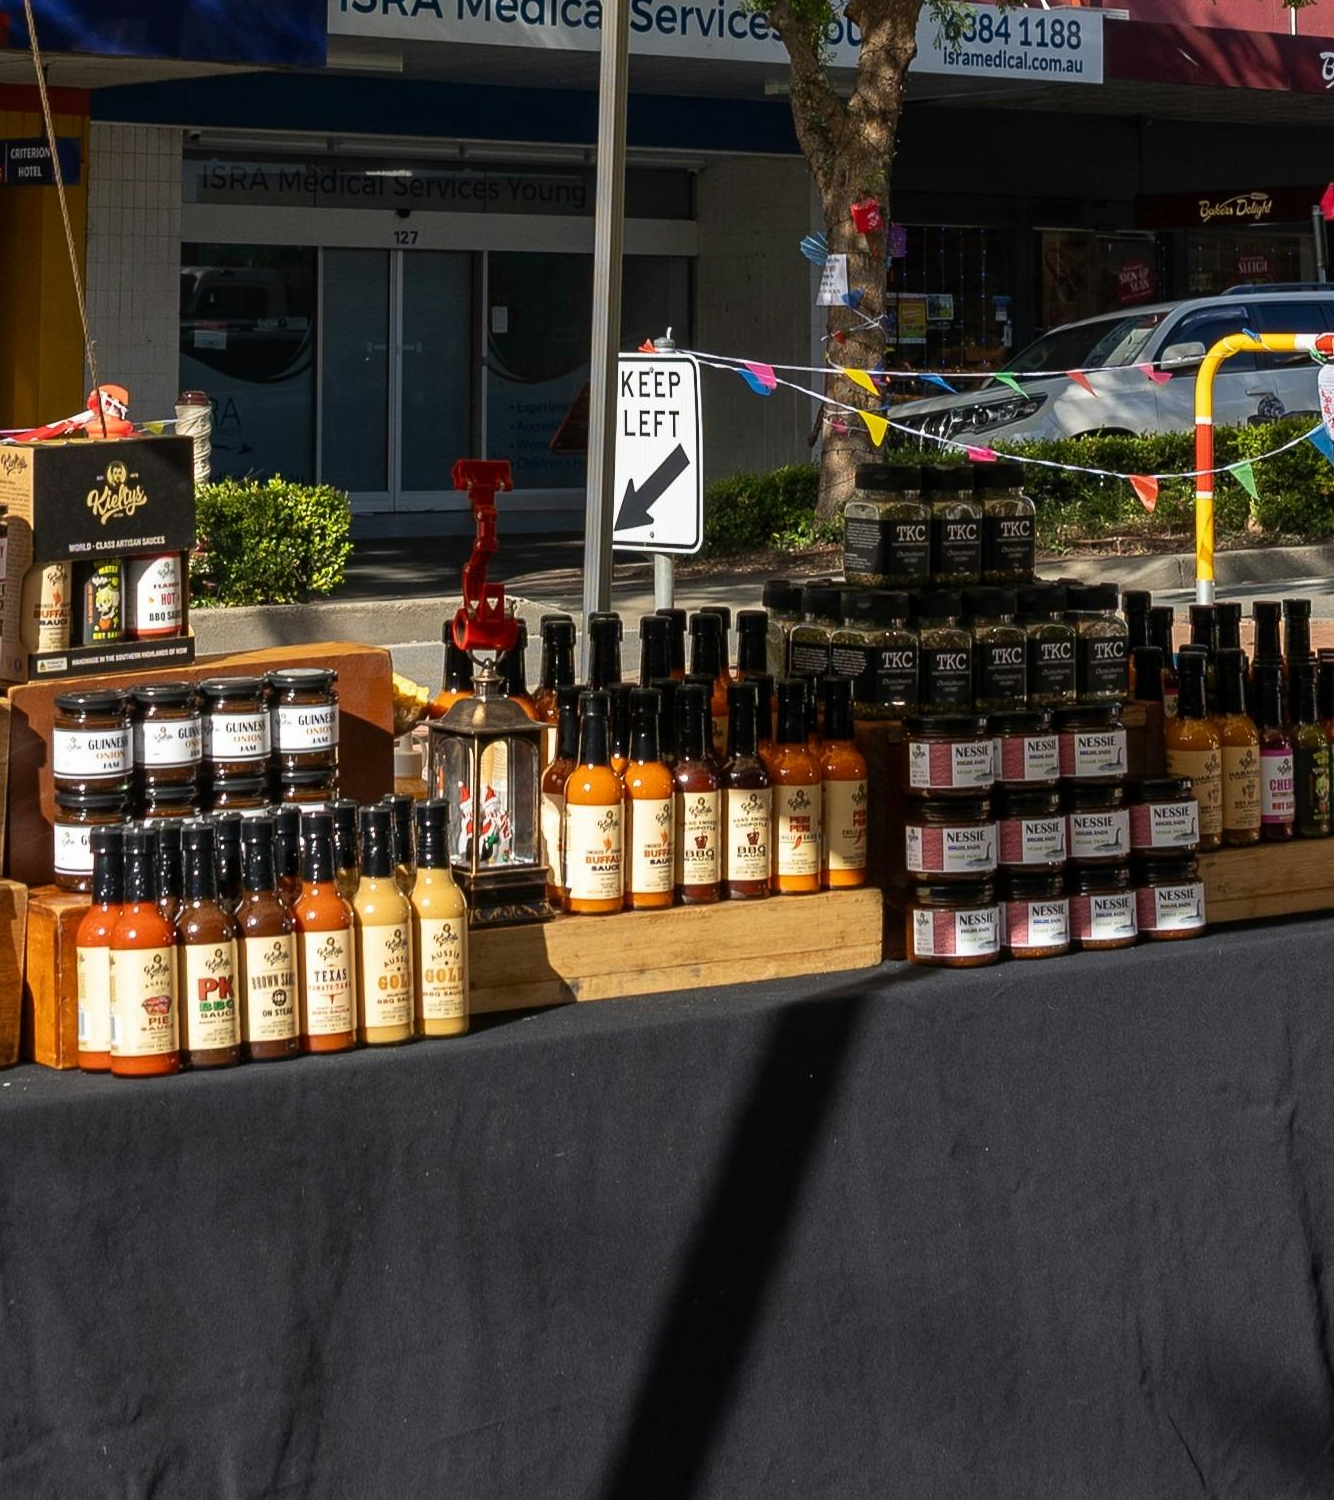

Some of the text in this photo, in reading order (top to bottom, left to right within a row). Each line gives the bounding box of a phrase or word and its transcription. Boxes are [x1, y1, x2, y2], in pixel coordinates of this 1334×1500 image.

[1019, 17, 1081, 50] 1188
[943, 47, 1083, 74] isramedical.com.au
[10, 148, 51, 161] CRITERION
[18, 165, 42, 179] HOTEL
[201, 164, 588, 209] ISRA Medical Services Young
[1199, 198, 1273, 223] Bakers Delight
[394, 230, 418, 246] 127
[620, 371, 681, 398] KEEP
[624, 410, 680, 438] LEFT
[86, 484, 148, 526] Kieltys
[896, 525, 926, 542] TKC
[947, 523, 977, 540] TKC
[225, 719, 266, 733] GUINNESS
[1078, 735, 1116, 747] NESSIE
[313, 970, 347, 983] TEXAS
[197, 977, 234, 1001] PK
[148, 1016, 170, 1027] PIE
